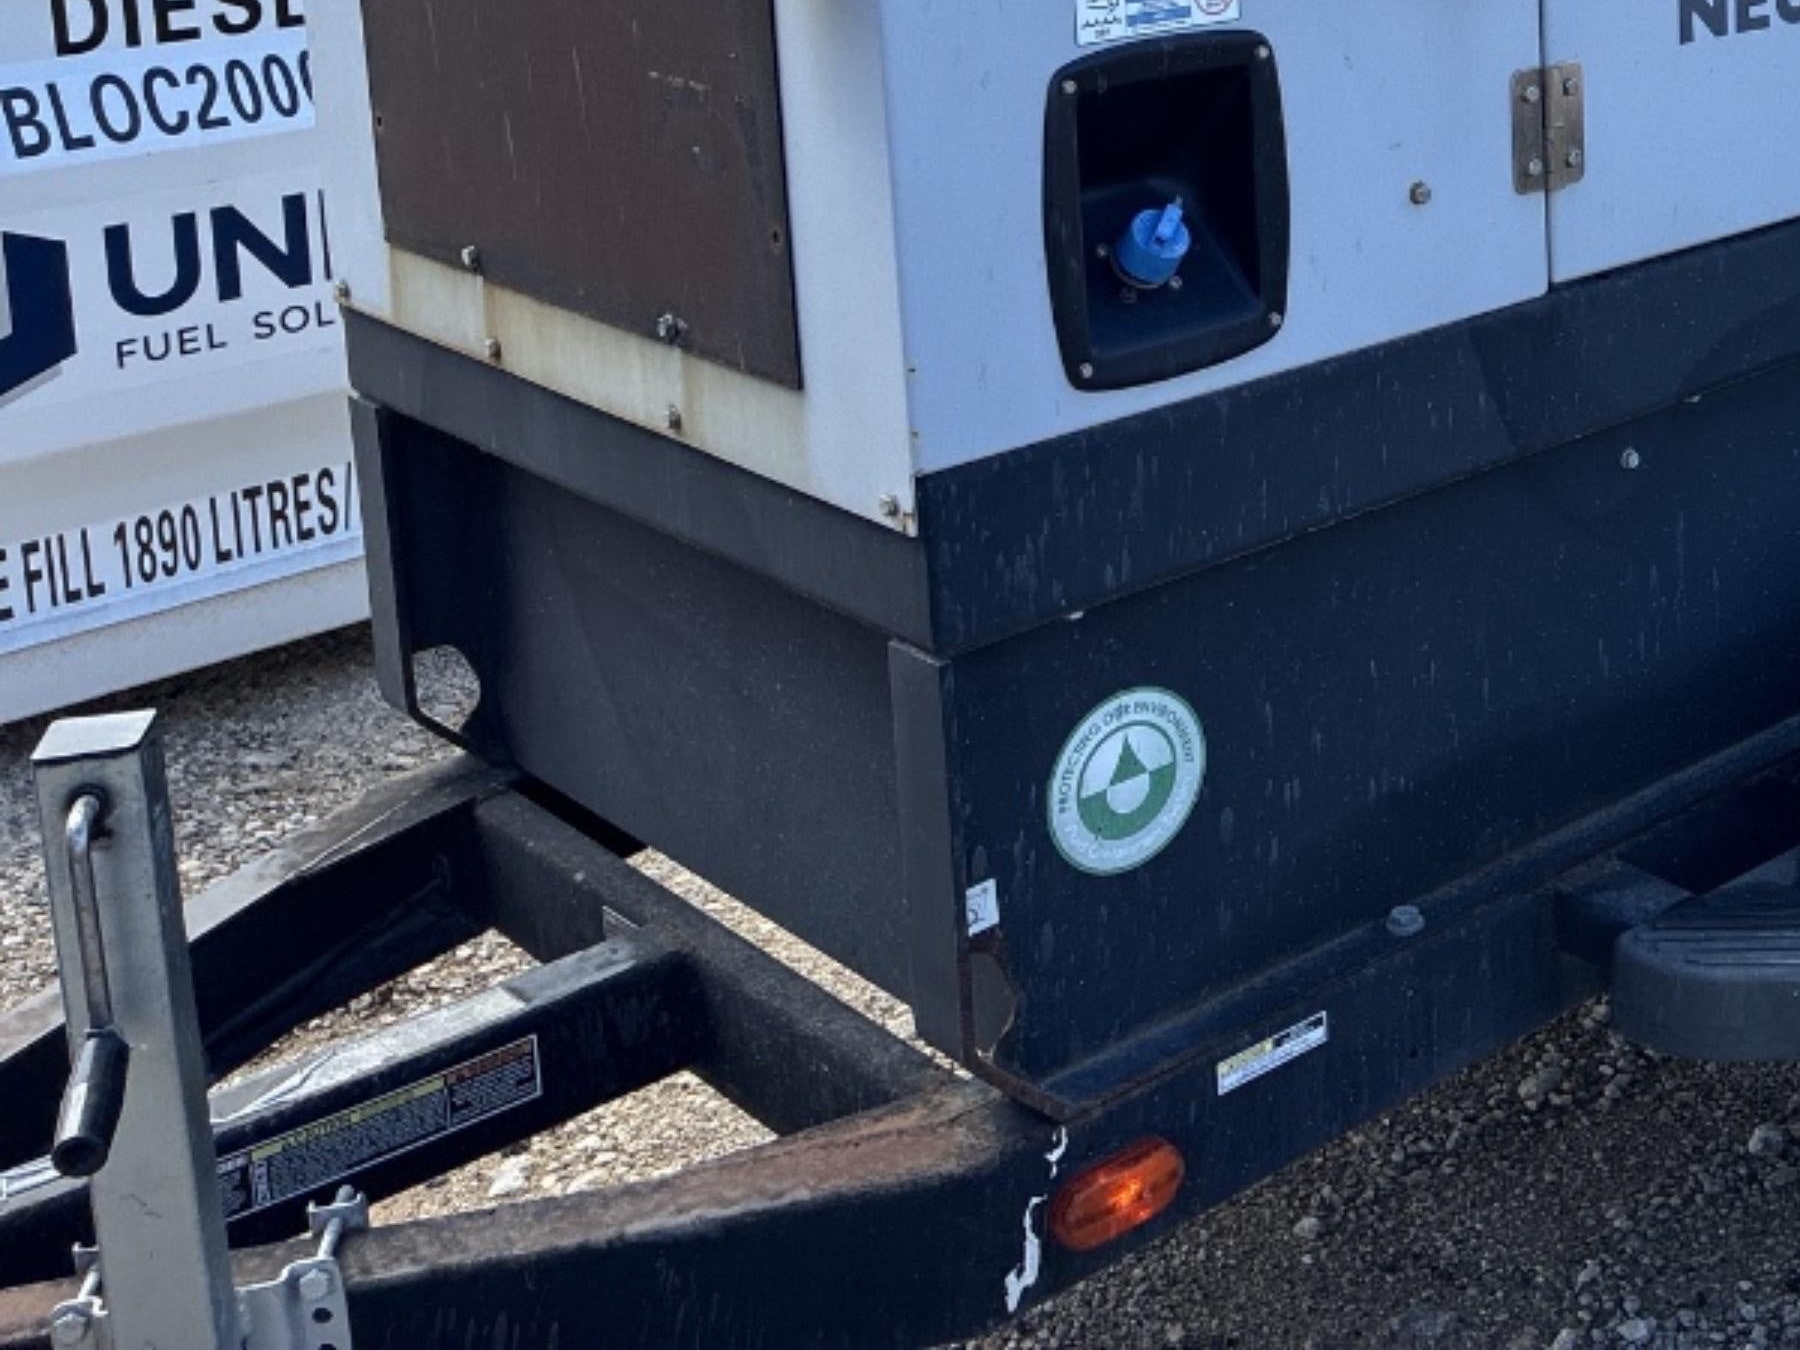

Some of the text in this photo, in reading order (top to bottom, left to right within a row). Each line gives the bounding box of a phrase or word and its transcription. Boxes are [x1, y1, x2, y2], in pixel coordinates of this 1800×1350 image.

[115, 300, 336, 370] FUEL SOL
[20, 528, 107, 613] FILL
[113, 503, 202, 589] 1890
